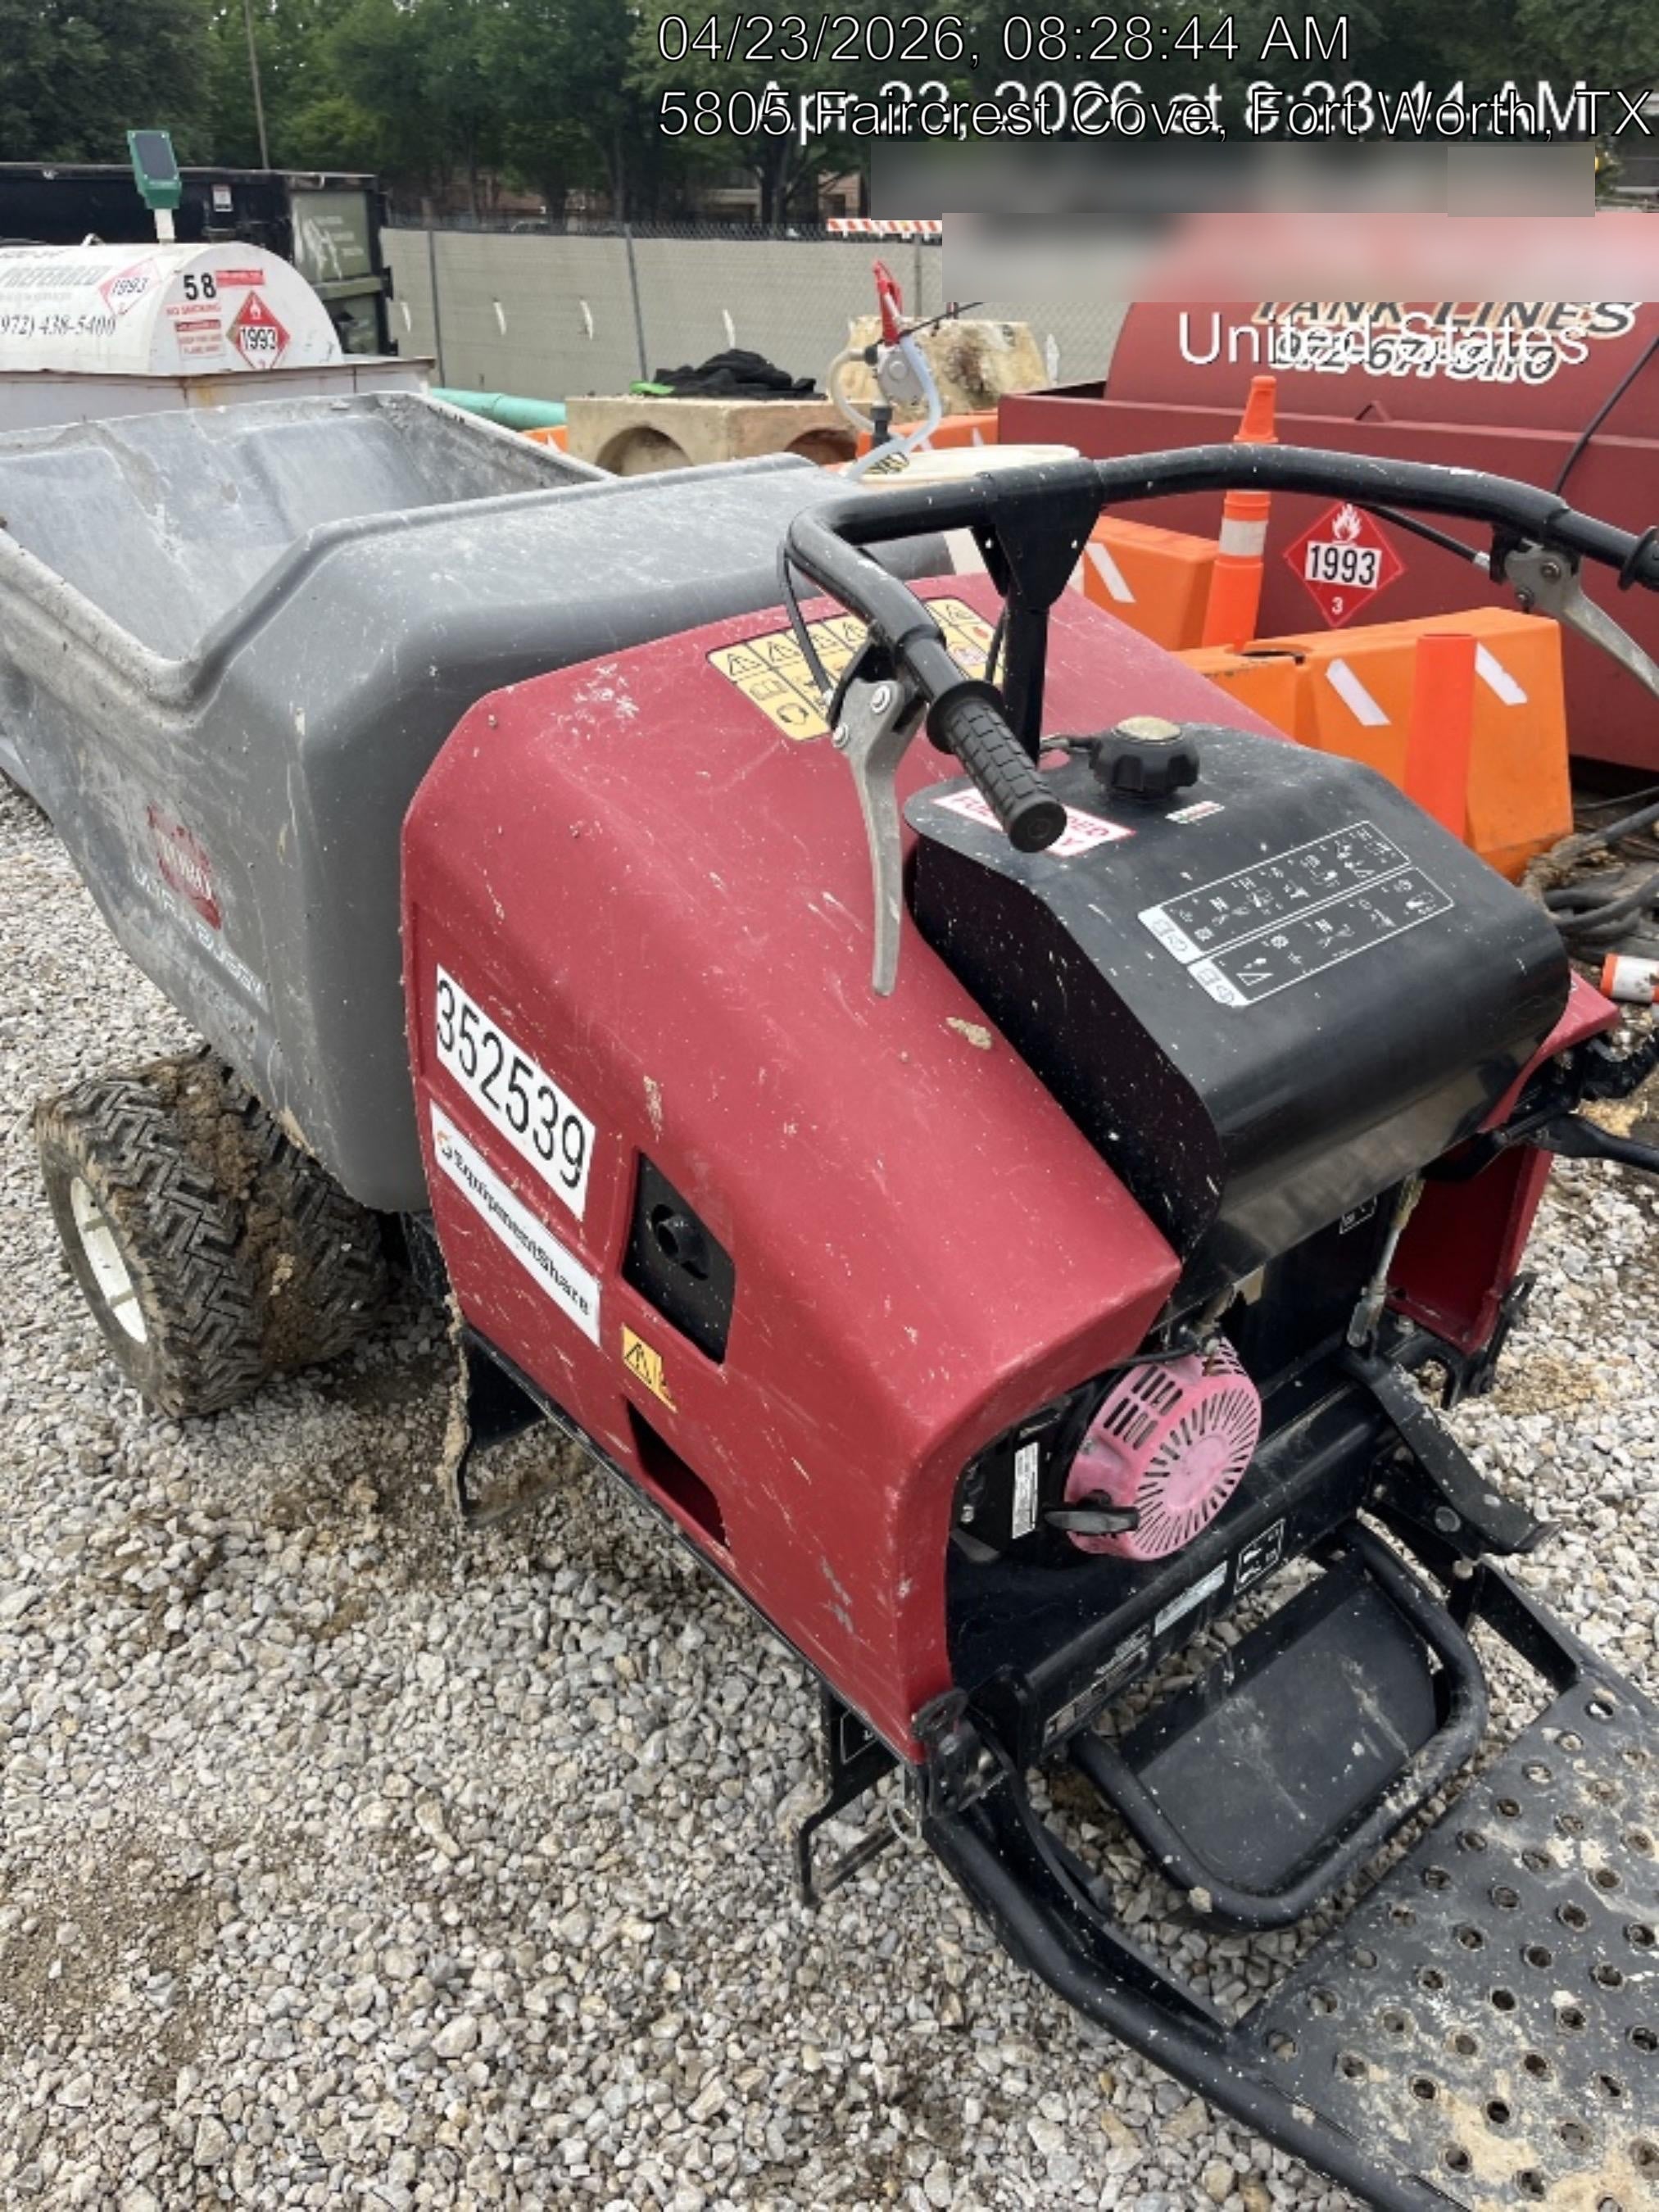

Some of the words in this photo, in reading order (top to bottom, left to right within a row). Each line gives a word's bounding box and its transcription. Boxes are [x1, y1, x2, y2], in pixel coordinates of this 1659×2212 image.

[241, 327, 276, 350] 1993
[1311, 545, 1376, 587] 1993
[1331, 596, 1344, 614] 3
[437, 979, 585, 1190] 352539
